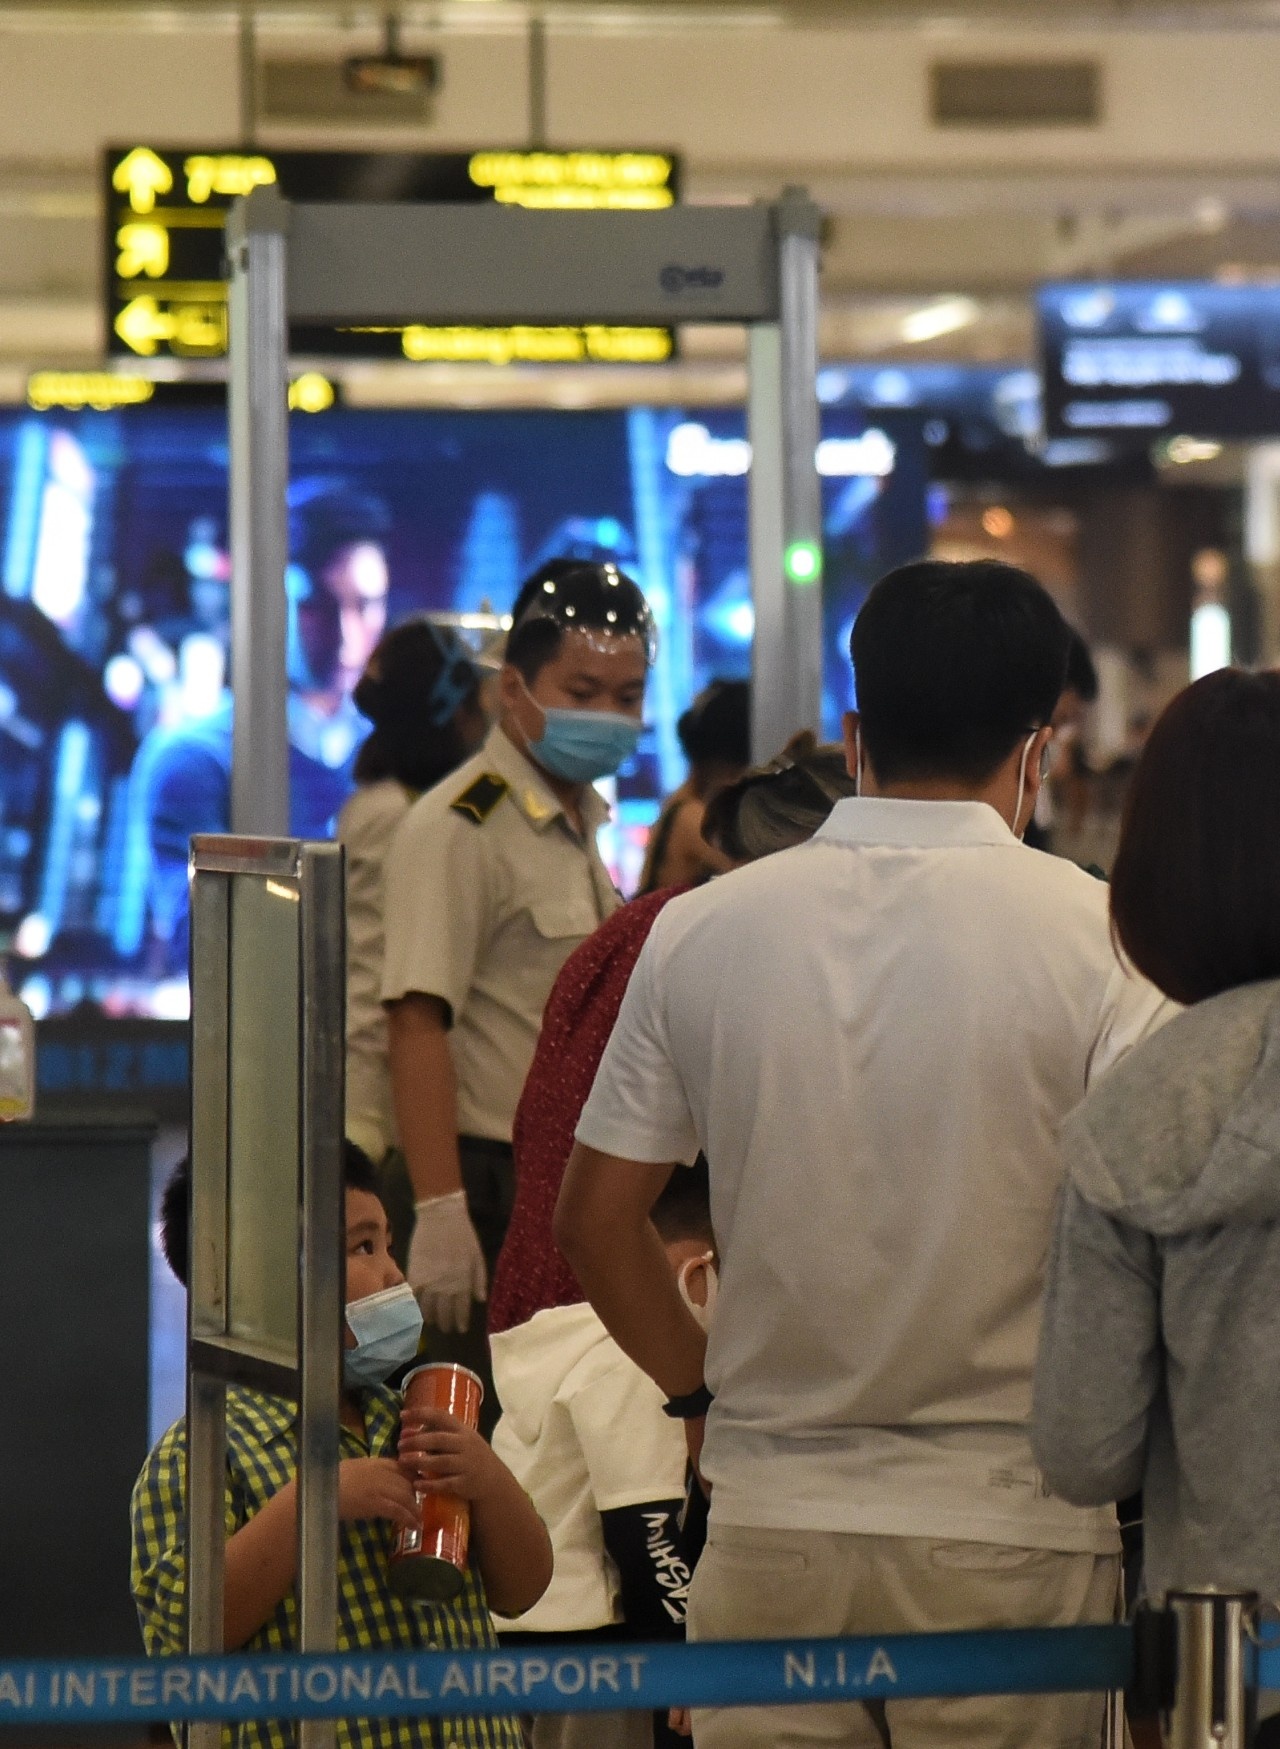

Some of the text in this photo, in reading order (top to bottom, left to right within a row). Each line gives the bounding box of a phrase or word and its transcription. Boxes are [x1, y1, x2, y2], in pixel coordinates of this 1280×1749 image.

[0, 1654, 647, 1708] AI INTERNATIONAL AIRPORT
[783, 1648, 898, 1689] N.I.A
